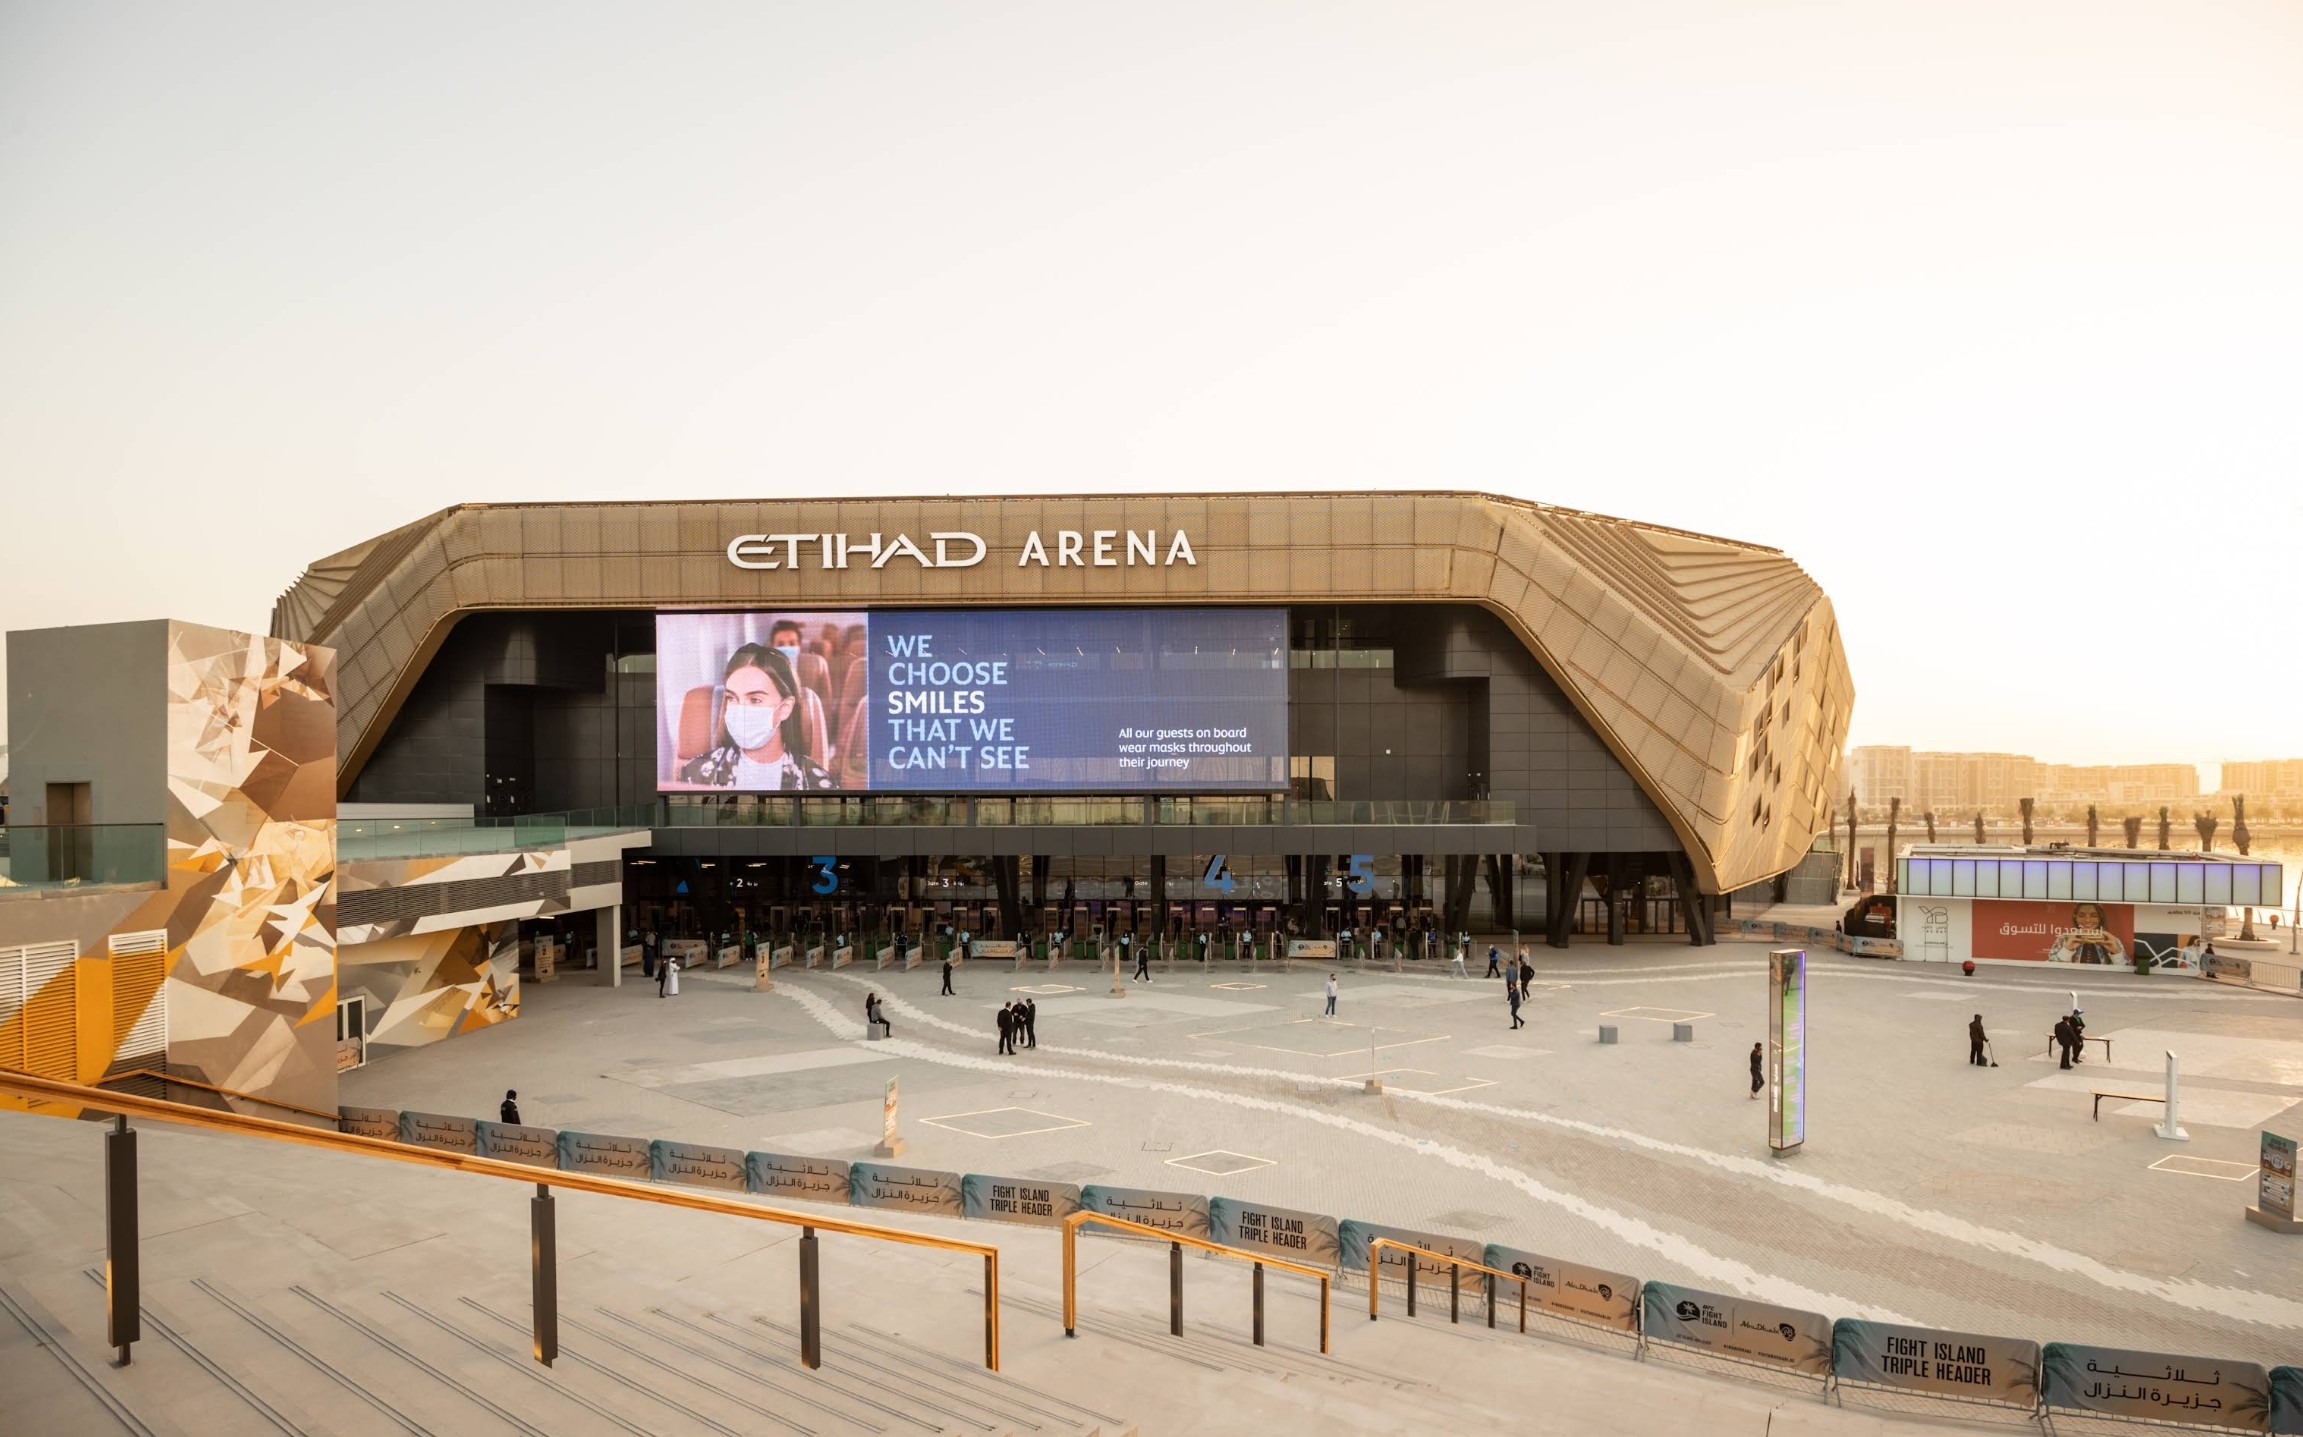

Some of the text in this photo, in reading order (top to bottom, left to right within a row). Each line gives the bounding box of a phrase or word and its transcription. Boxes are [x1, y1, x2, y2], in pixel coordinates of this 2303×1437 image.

[727, 530, 1197, 569] ETIHAD ARENA
[887, 635, 933, 657] WE
[888, 662, 1008, 685] CHOOSE
[888, 691, 985, 714] SMILES
[888, 719, 1015, 741] THAT WE
[1119, 727, 1247, 740] All our guests on board
[980, 746, 1030, 769] SEE
[1119, 742, 1252, 755] wear masks throughout
[1119, 757, 1190, 770] their journey
[812, 855, 839, 895] 3
[1203, 855, 1234, 894] 4
[1336, 878, 1342, 887] 5
[1348, 854, 1376, 893] 5
[942, 878, 949, 888] 3
[2000, 922, 2046, 936] للتسوق
[767, 1160, 829, 1176] ثلاثية
[766, 1175, 830, 1191] جزيرة النزال
[872, 1172, 939, 1188] ثلاثية
[871, 1187, 940, 1205] جزيرة النزال
[992, 1185, 1049, 1203] FIGHT ISLAND
[990, 1198, 1053, 1217] TRIPLE HEADER
[1106, 1196, 1182, 1212] ثلاثية
[1143, 1215, 1184, 1229] جزيرة
[1242, 1211, 1304, 1234] FIGHT ISLAND
[1238, 1225, 1307, 1250] TRIPLE HEADER
[1533, 1270, 1551, 1280] FIGHT
[1533, 1278, 1555, 1288] ISLAND
[1702, 1310, 1722, 1320] FIGHT
[1702, 1317, 1728, 1329] ISLAND
[1887, 1336, 1986, 1365] FIGHT ISLAND
[1881, 1355, 1991, 1386] TRIPLE HEADER
[2087, 1359, 2220, 1385] ثلاثية
[2084, 1382, 2222, 1412] جزيرة النزال
